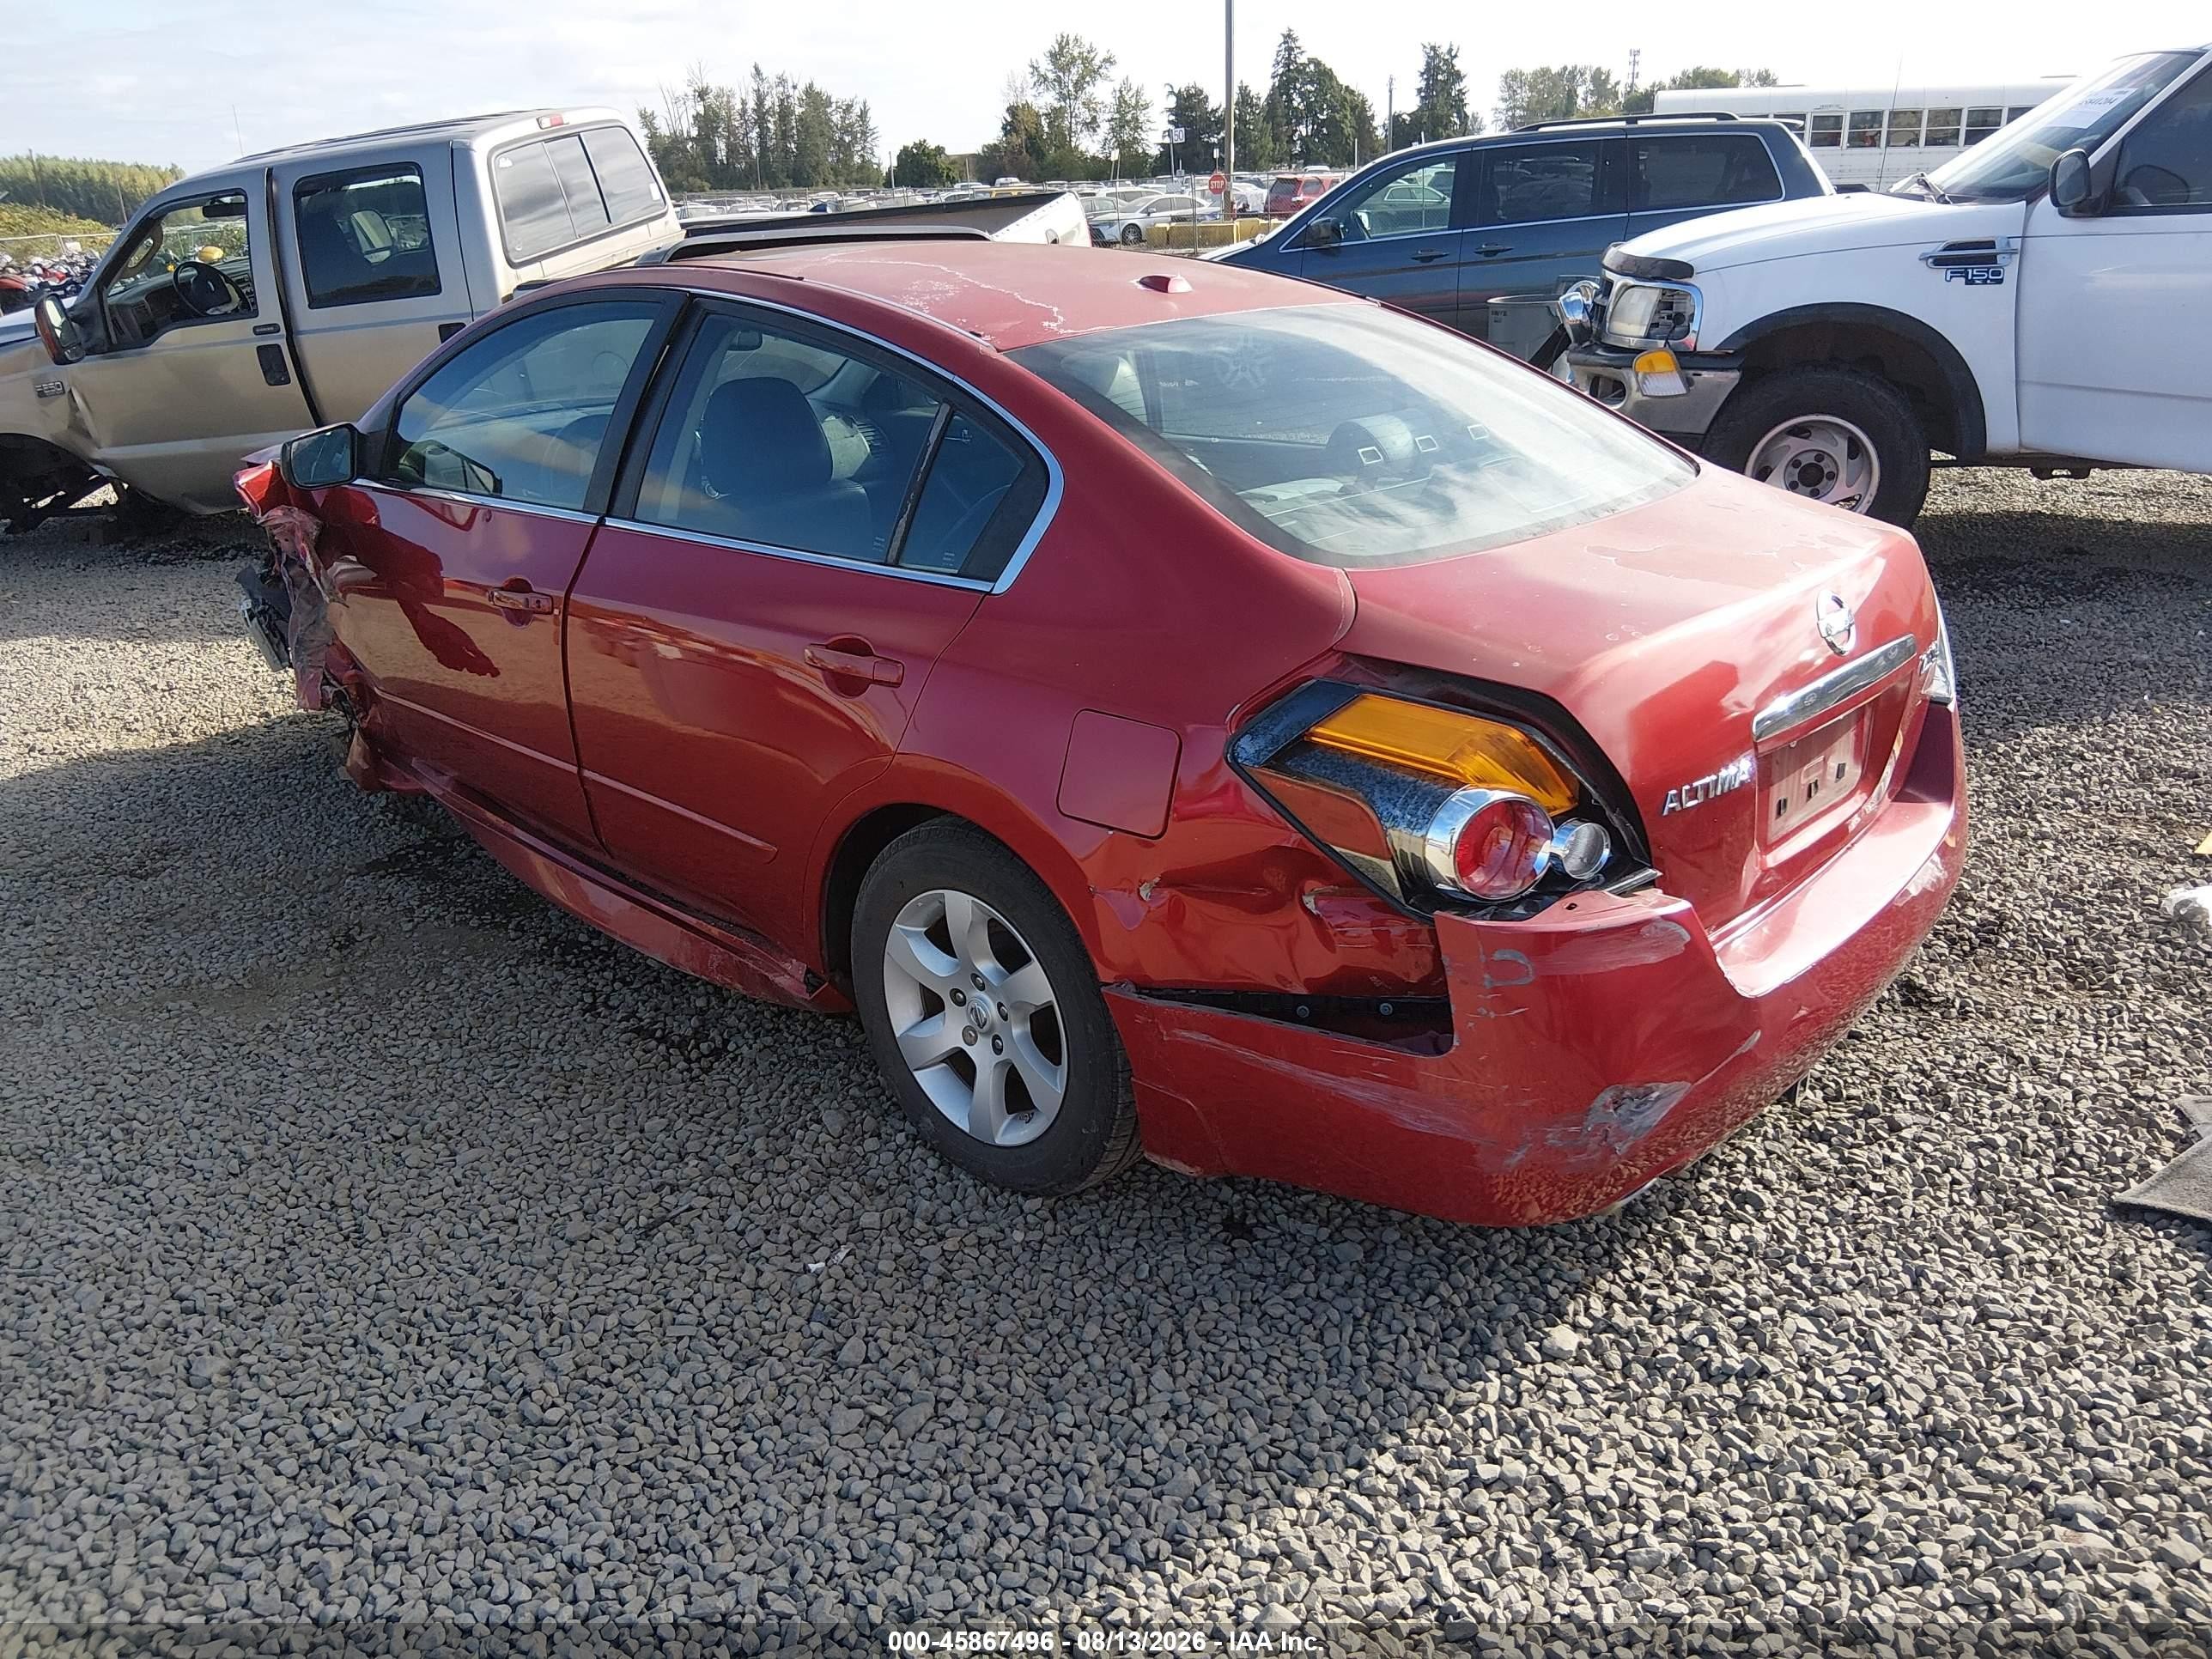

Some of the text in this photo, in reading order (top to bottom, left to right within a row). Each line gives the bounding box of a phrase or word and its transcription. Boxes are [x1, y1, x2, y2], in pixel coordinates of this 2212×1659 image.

[1210, 180, 1224, 190] STOP
[1945, 268, 2004, 283] F150
[1662, 758, 1753, 816] ALTIMA
